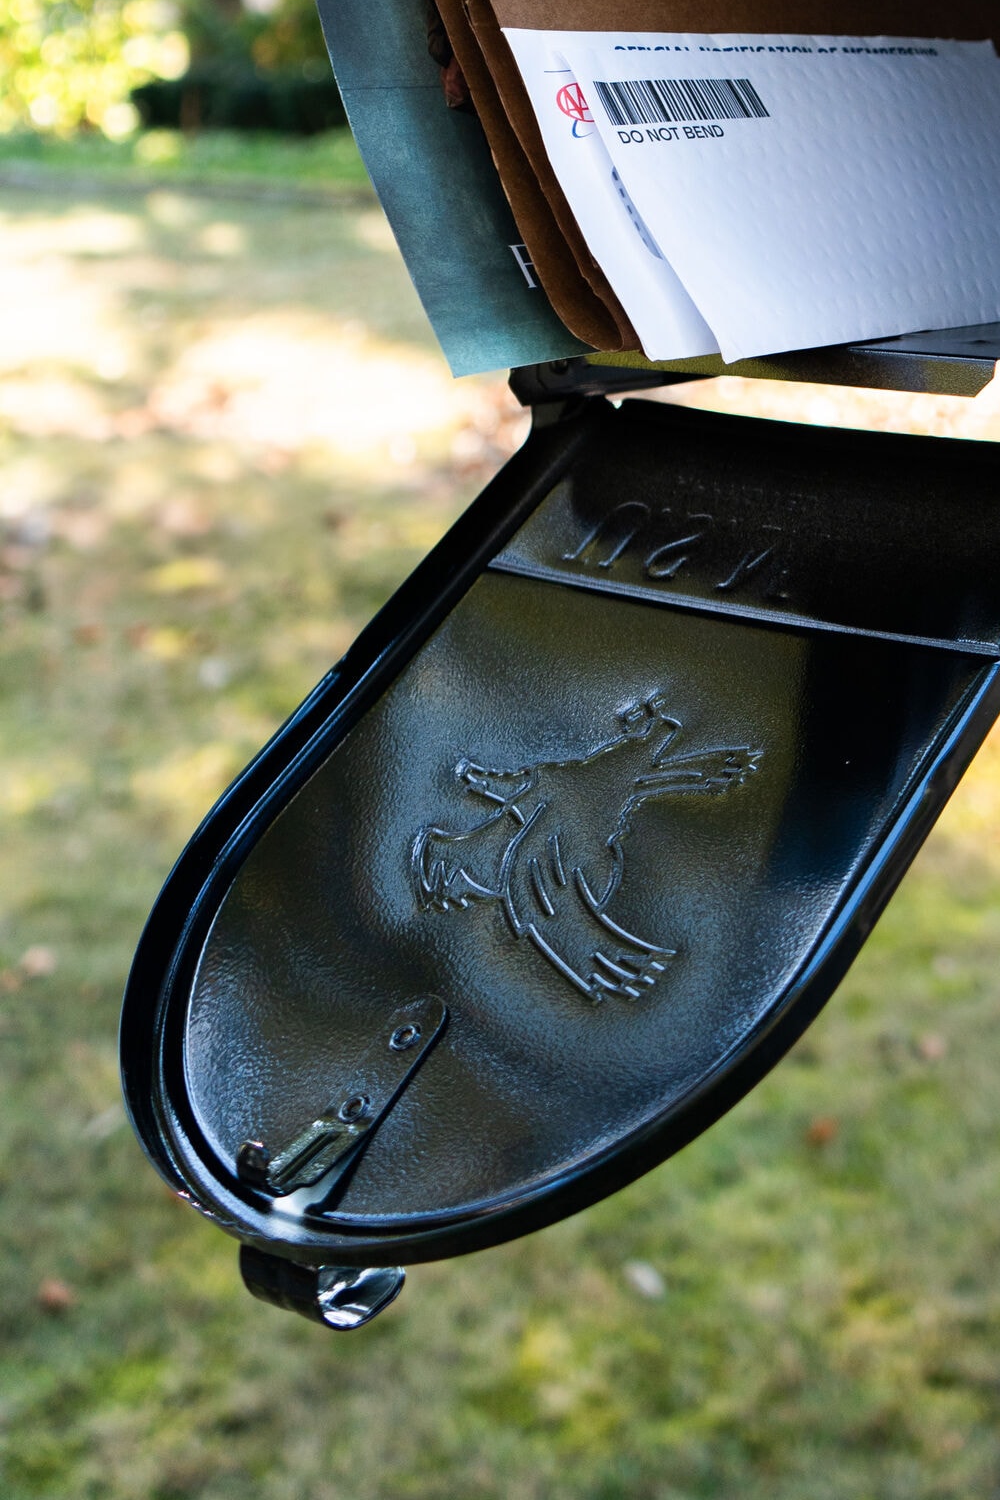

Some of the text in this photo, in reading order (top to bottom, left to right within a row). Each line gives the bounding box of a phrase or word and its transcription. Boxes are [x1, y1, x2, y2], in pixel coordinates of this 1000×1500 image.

[617, 124, 725, 143] DO NOT BEND
